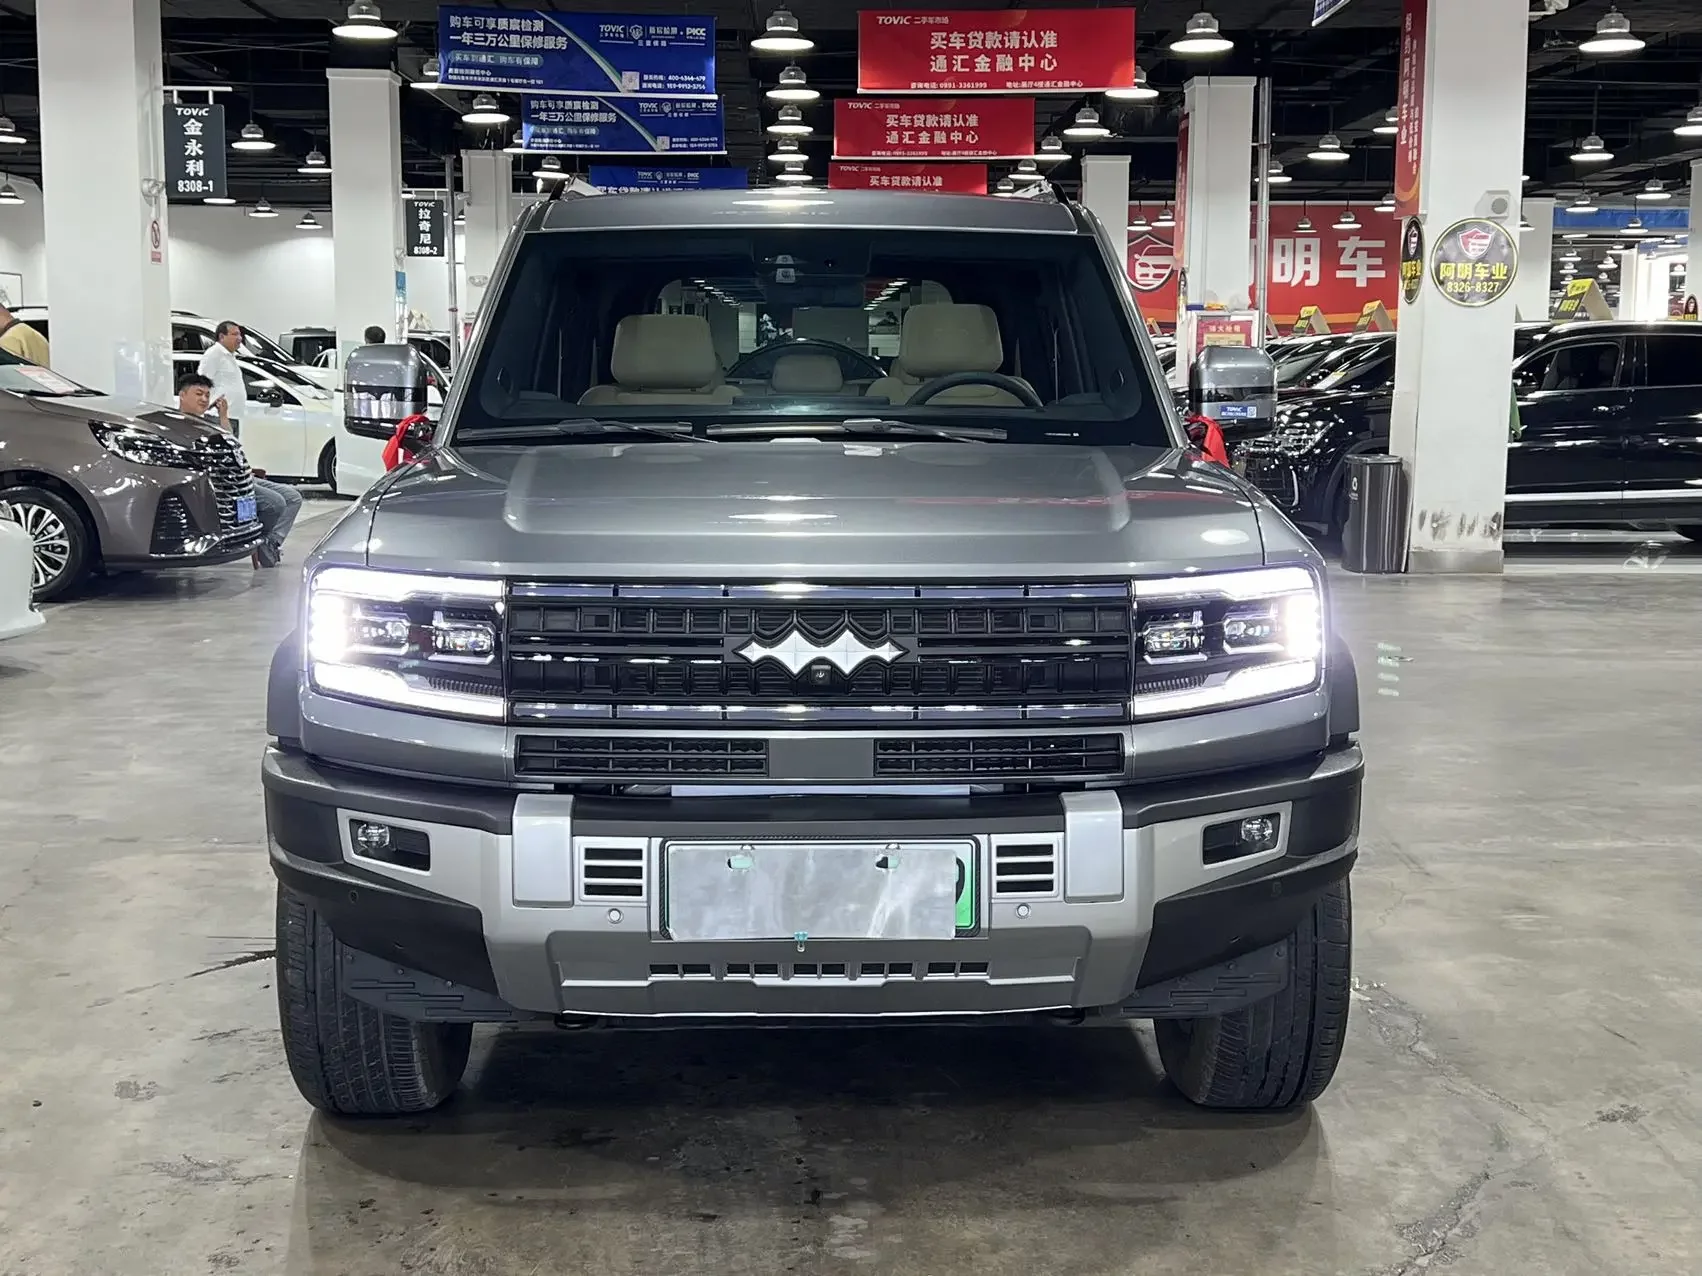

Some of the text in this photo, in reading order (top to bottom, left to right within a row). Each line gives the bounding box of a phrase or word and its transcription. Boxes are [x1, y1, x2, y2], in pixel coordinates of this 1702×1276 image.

[876, 16, 912, 25] TOVIC
[599, 24, 625, 33] TOVIC
[449, 32, 568, 50] 一年三万公里保修服务
[930, 30, 1058, 50] 买车贷款请认准
[930, 53, 1058, 73] 通汇金融中心
[176, 107, 210, 116] TOVIC
[886, 114, 979, 128] 买车贷款请认准
[886, 130, 979, 144] 通汇金融中心
[183, 118, 204, 177] 金永利
[177, 180, 214, 193] 8308-1
[869, 175, 943, 187] 买车贷款请认准
[418, 208, 431, 244] 拉奇尼
[413, 246, 438, 255] 8308-2
[1439, 262, 1508, 280] 阿明车业
[1446, 281, 1500, 293] 8326-8327
